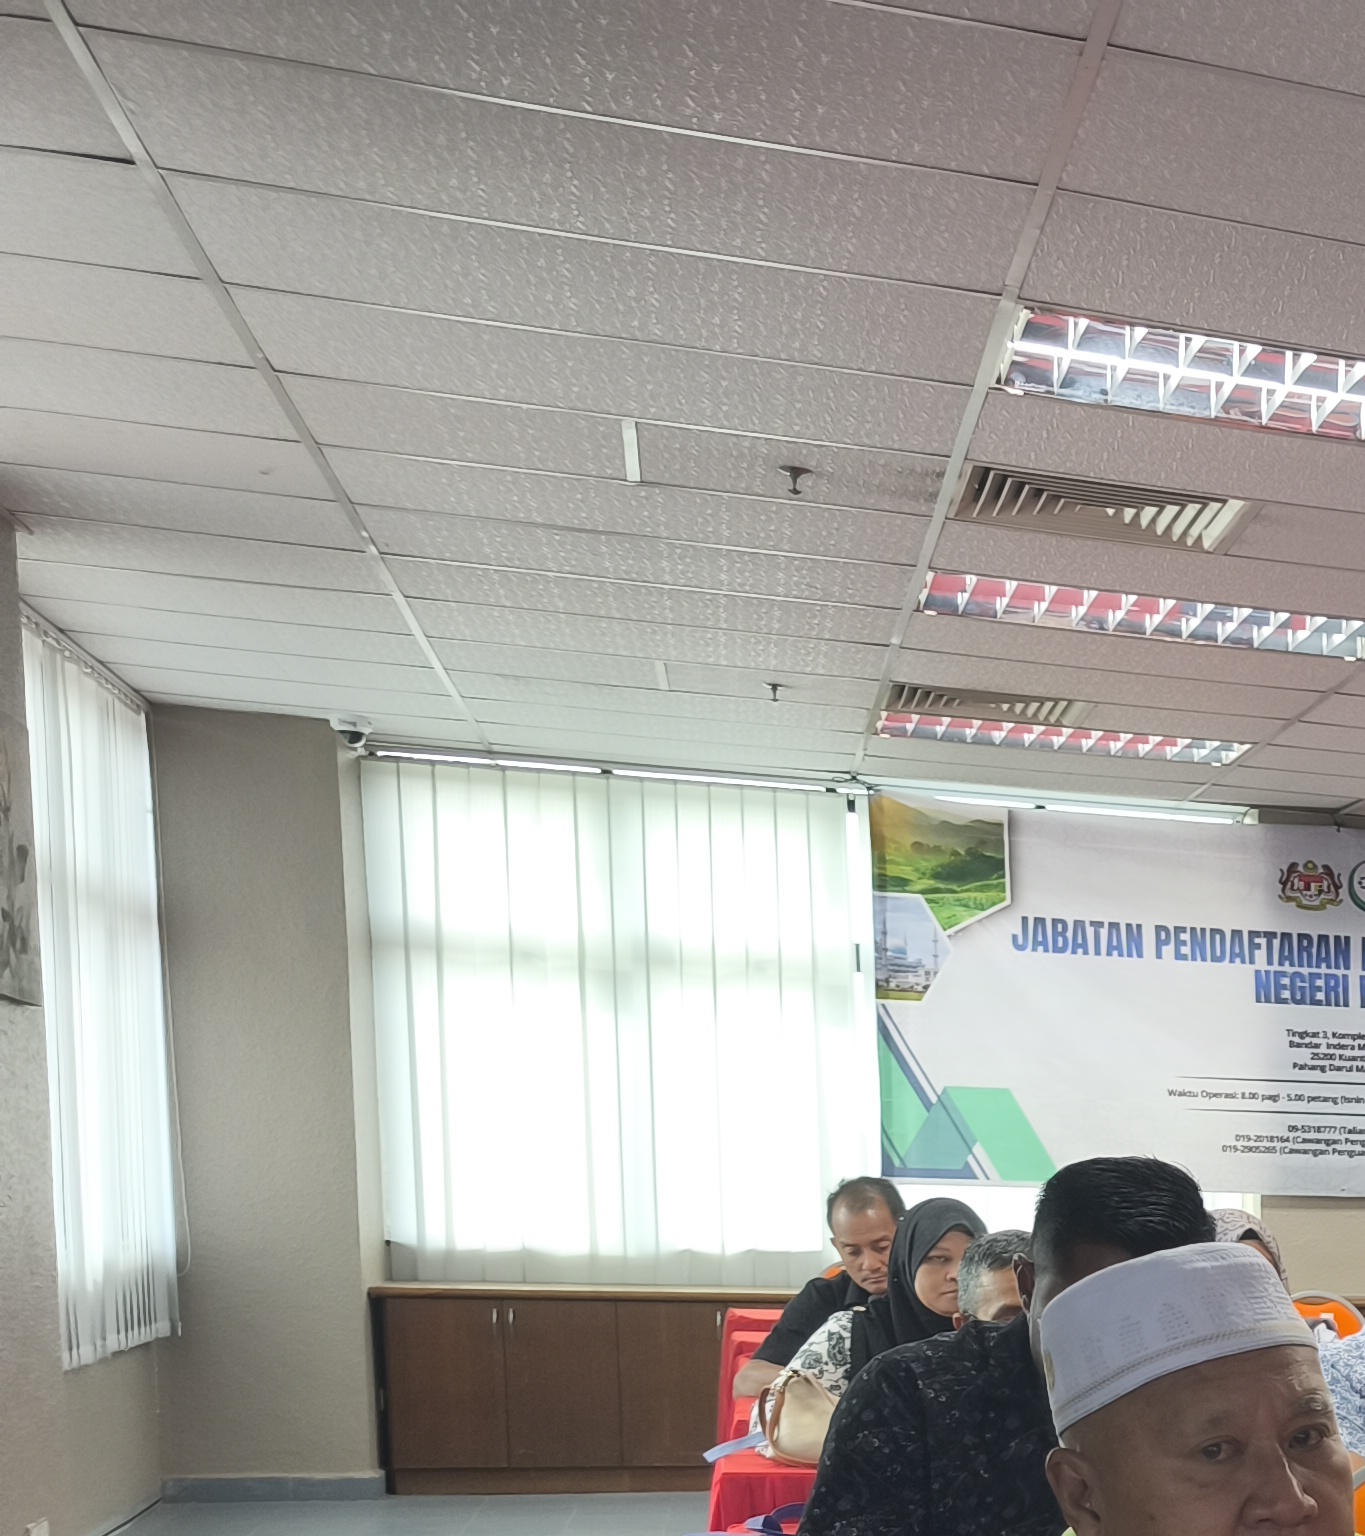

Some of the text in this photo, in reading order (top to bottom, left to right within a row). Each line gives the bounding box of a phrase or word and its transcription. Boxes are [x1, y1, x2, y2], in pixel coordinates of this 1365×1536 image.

[1011, 915, 1144, 959] JABATAN
[1154, 924, 1351, 970] PENDAFTARAN
[1254, 969, 1350, 1008] NEGERI
[1286, 1029, 1320, 1040] Tingkat
[1289, 1040, 1322, 1049] Bandar
[1326, 1042, 1355, 1051] Indera
[1292, 1062, 1327, 1073] Pahang
[1329, 1063, 1354, 1073] Darul
[1167, 1088, 1198, 1098] Waktu
[1201, 1090, 1239, 1100] Operasi:
[1261, 1093, 1280, 1103] pagi
[1307, 1095, 1339, 1105] petang
[1292, 1136, 1342, 1147] (Cawangan
[1279, 1146, 1330, 1157] (Cawangan
